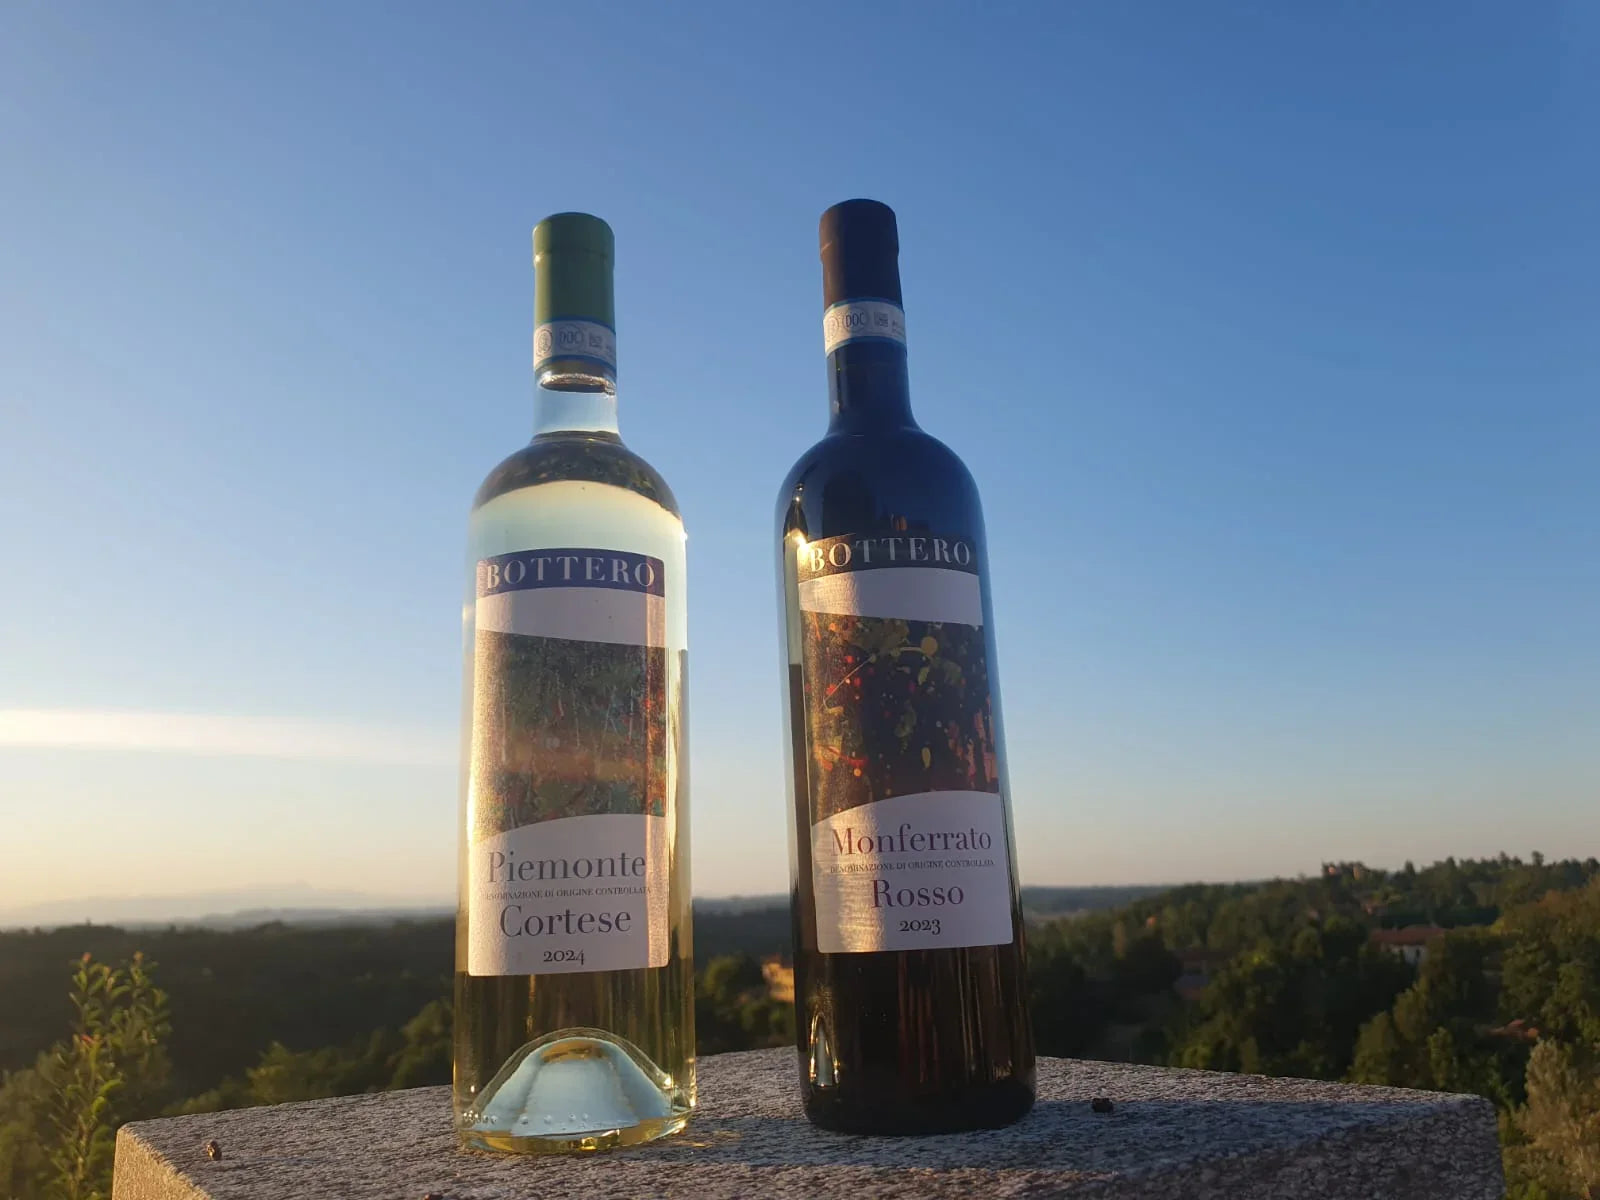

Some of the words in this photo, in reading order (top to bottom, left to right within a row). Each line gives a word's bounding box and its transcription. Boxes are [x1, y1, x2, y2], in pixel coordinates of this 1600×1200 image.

[809, 537, 971, 572] BOTTERO
[486, 556, 656, 590] BOTTERO
[830, 823, 992, 857] Monferrato
[487, 851, 646, 884] Piemonte
[830, 862, 895, 874] DENOMINAZIONE
[896, 861, 906, 871] DI
[907, 860, 944, 870] ORIGINE
[945, 858, 995, 868] CONTROLLATA
[544, 888, 554, 898] DI
[556, 887, 594, 897] ORIGINE
[595, 885, 651, 896] CONTROLLATA
[870, 879, 964, 909] Rosso
[500, 904, 632, 938] Cortese
[899, 919, 942, 936] 2023
[543, 949, 586, 966] 2024
